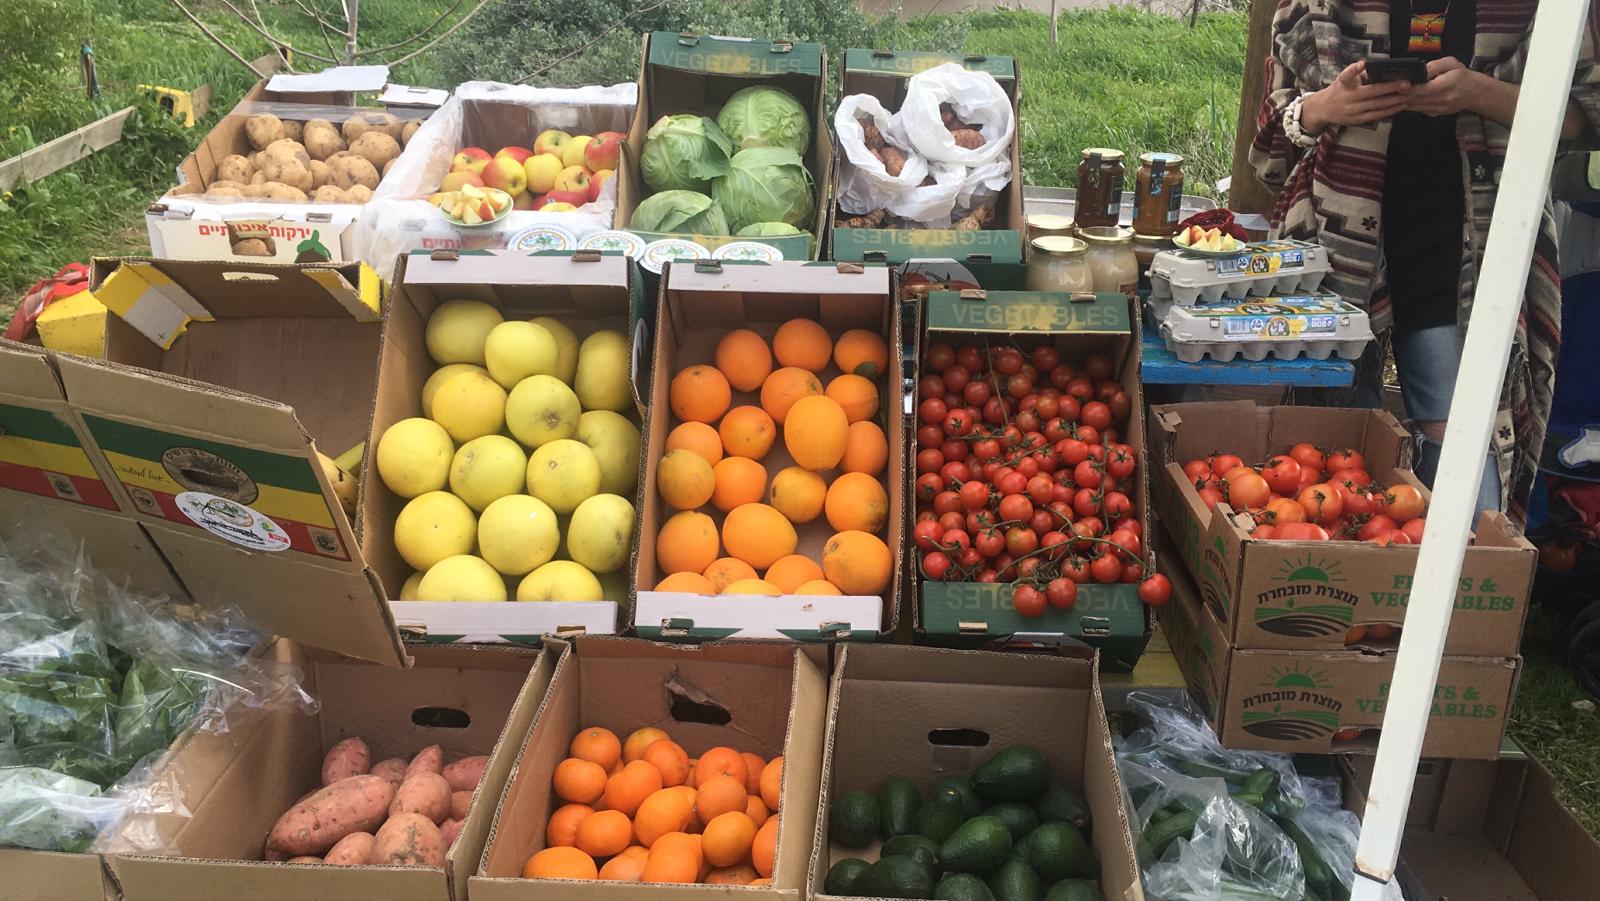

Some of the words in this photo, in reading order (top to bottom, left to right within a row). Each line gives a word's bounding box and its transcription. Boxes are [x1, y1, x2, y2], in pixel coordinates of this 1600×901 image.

[269, 226, 311, 240] ירקות
[951, 303, 1119, 326] VEGETABLES
[1258, 584, 1312, 604] מובחרת
[1480, 578, 1497, 592] &
[946, 585, 1130, 612] VEGBLES
[1315, 585, 1359, 606] תוצרת
[1243, 690, 1297, 708] מובחרת
[1300, 691, 1342, 712] תוצרת
[1463, 686, 1480, 700] &
[1357, 698, 1498, 718] VEABLES
